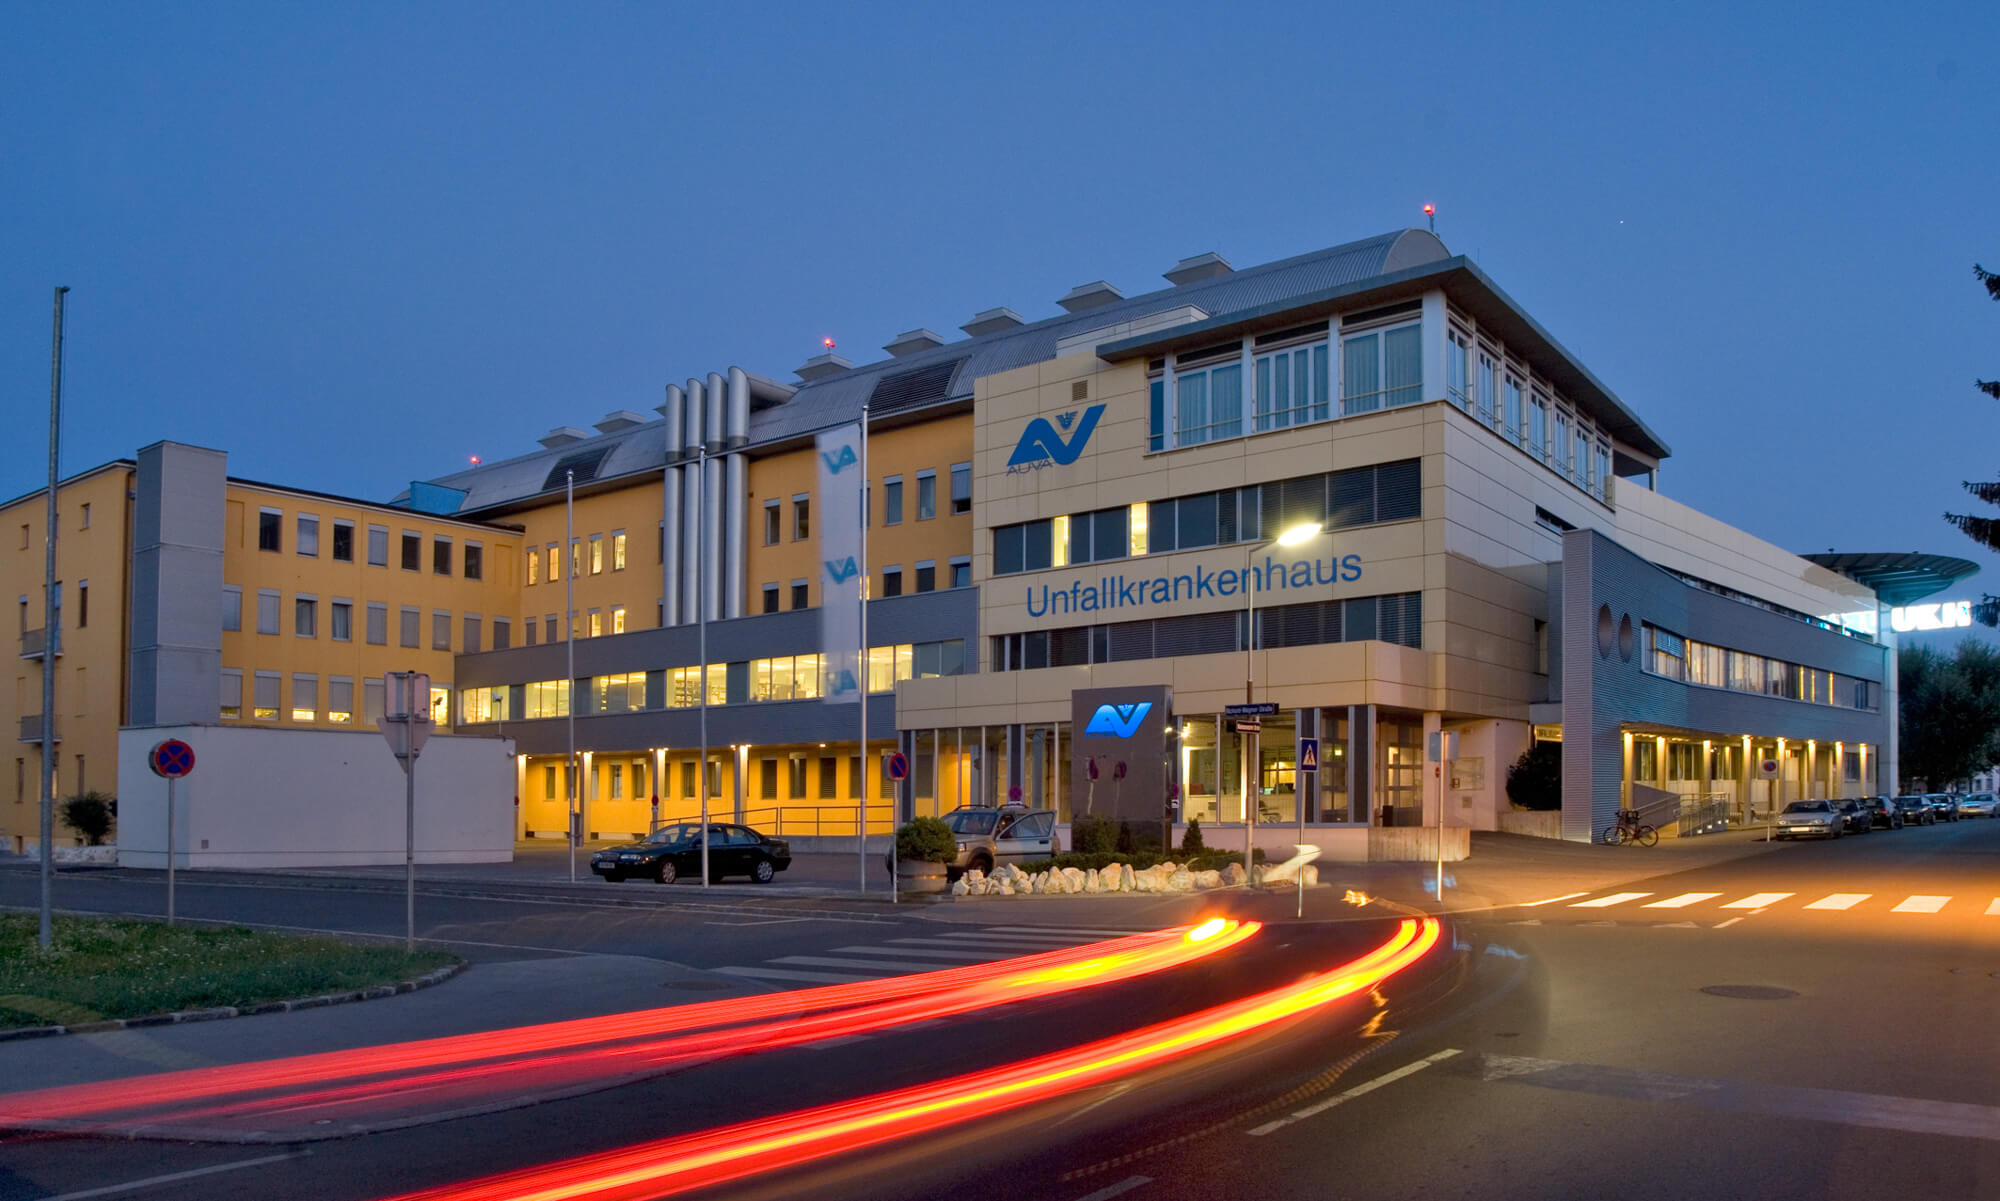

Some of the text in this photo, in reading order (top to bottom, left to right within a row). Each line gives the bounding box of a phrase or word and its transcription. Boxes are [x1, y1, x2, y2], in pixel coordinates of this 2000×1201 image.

[1006, 459, 1053, 477] AUVA
[1026, 554, 1362, 618] Unfallkrankenhaus
[1891, 601, 1972, 632] UKH
